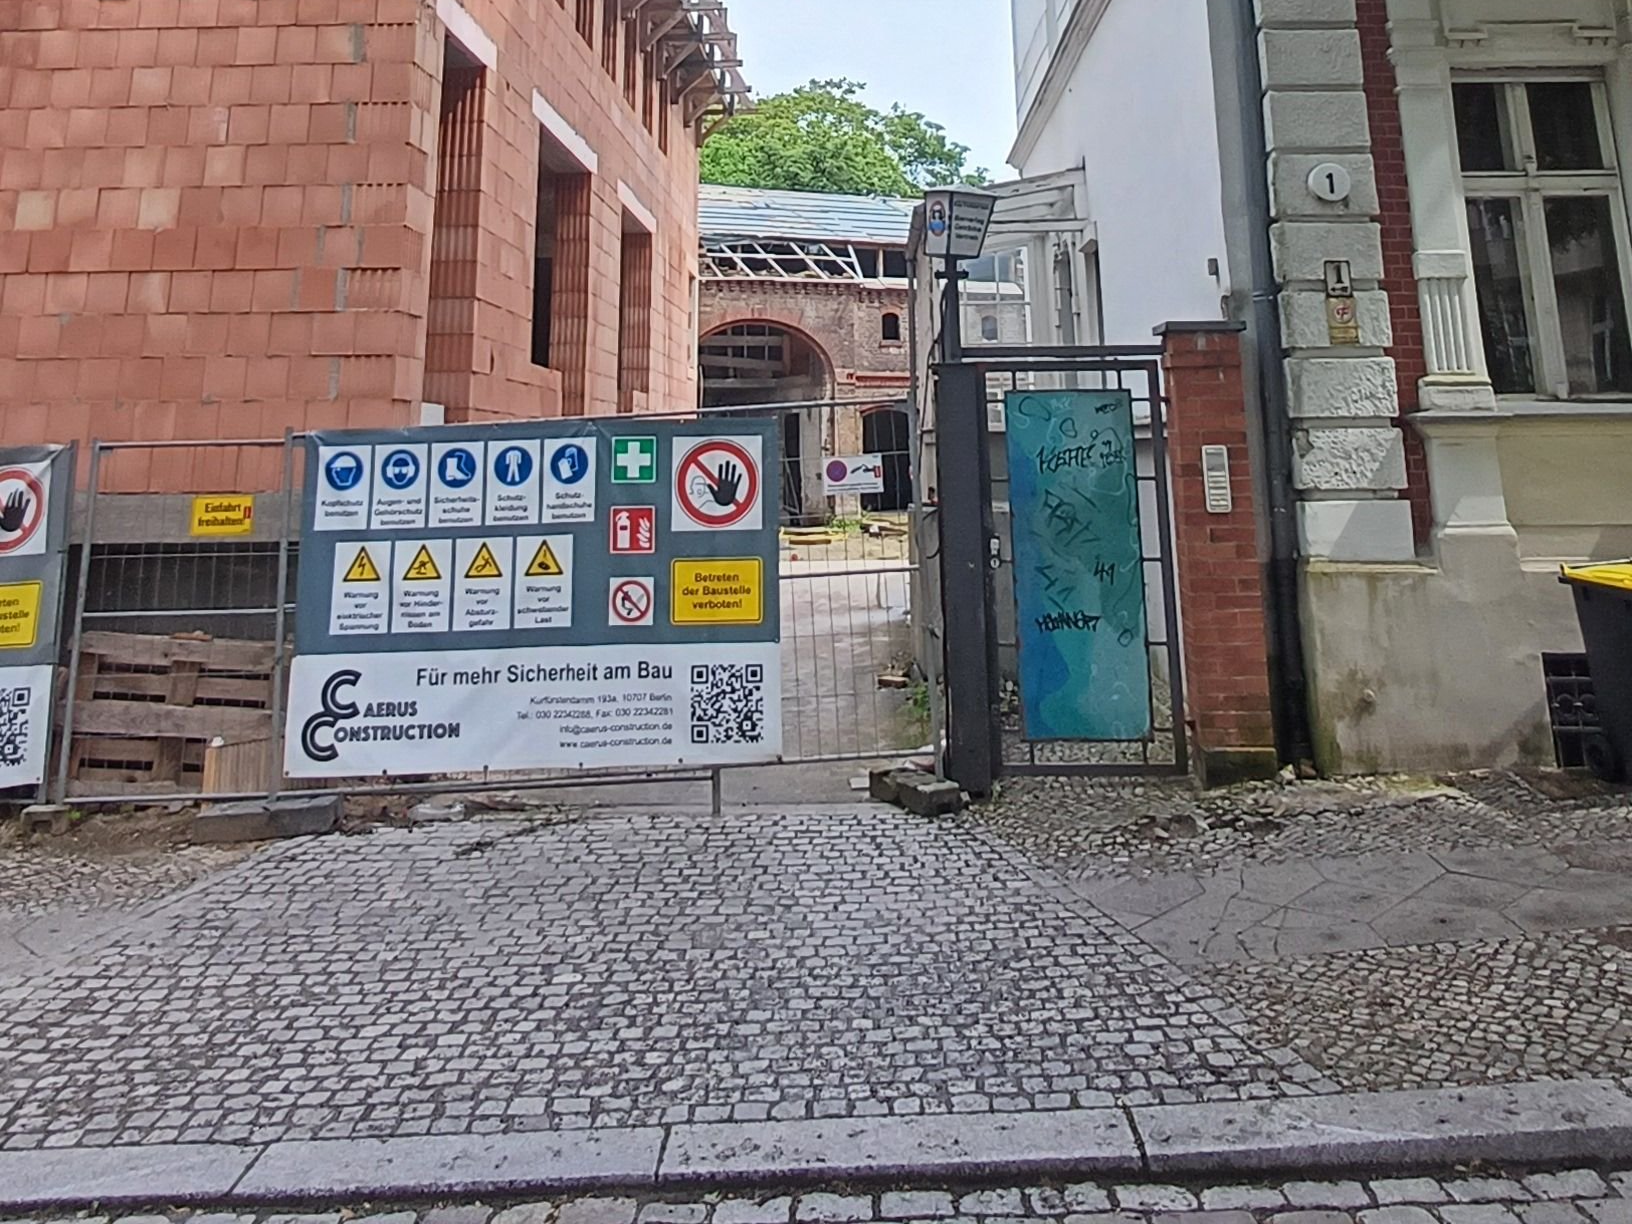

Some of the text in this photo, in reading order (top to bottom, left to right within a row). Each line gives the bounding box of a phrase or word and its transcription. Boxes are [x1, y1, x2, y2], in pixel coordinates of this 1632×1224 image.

[1326, 173, 1335, 194] 1
[1334, 264, 1344, 284] 1
[497, 493, 526, 502] Schutz-
[555, 491, 584, 499] Schutz-
[407, 497, 422, 505] und
[442, 506, 471, 514] schuhe
[694, 572, 739, 583] Betreten
[403, 589, 440, 598] Warnung
[465, 587, 500, 596] Warnung
[526, 585, 562, 594] Warnung
[682, 584, 752, 596] der Baustelle
[344, 591, 379, 600] Warnung
[692, 598, 743, 609] verboten!
[407, 620, 433, 628] Boden
[468, 618, 494, 628] gefahr
[534, 616, 552, 624] Last
[416, 661, 673, 686] Für mehr Sicherheit am Bau
[529, 695, 595, 705] Kurfürstendamm
[622, 693, 647, 703] 10707
[649, 692, 673, 702] Berlin
[535, 710, 551, 719] 030
[615, 708, 632, 717] 030
[559, 723, 673, 736] info@caerus-construction.de
[559, 737, 673, 749] www.caerus-construction.de
